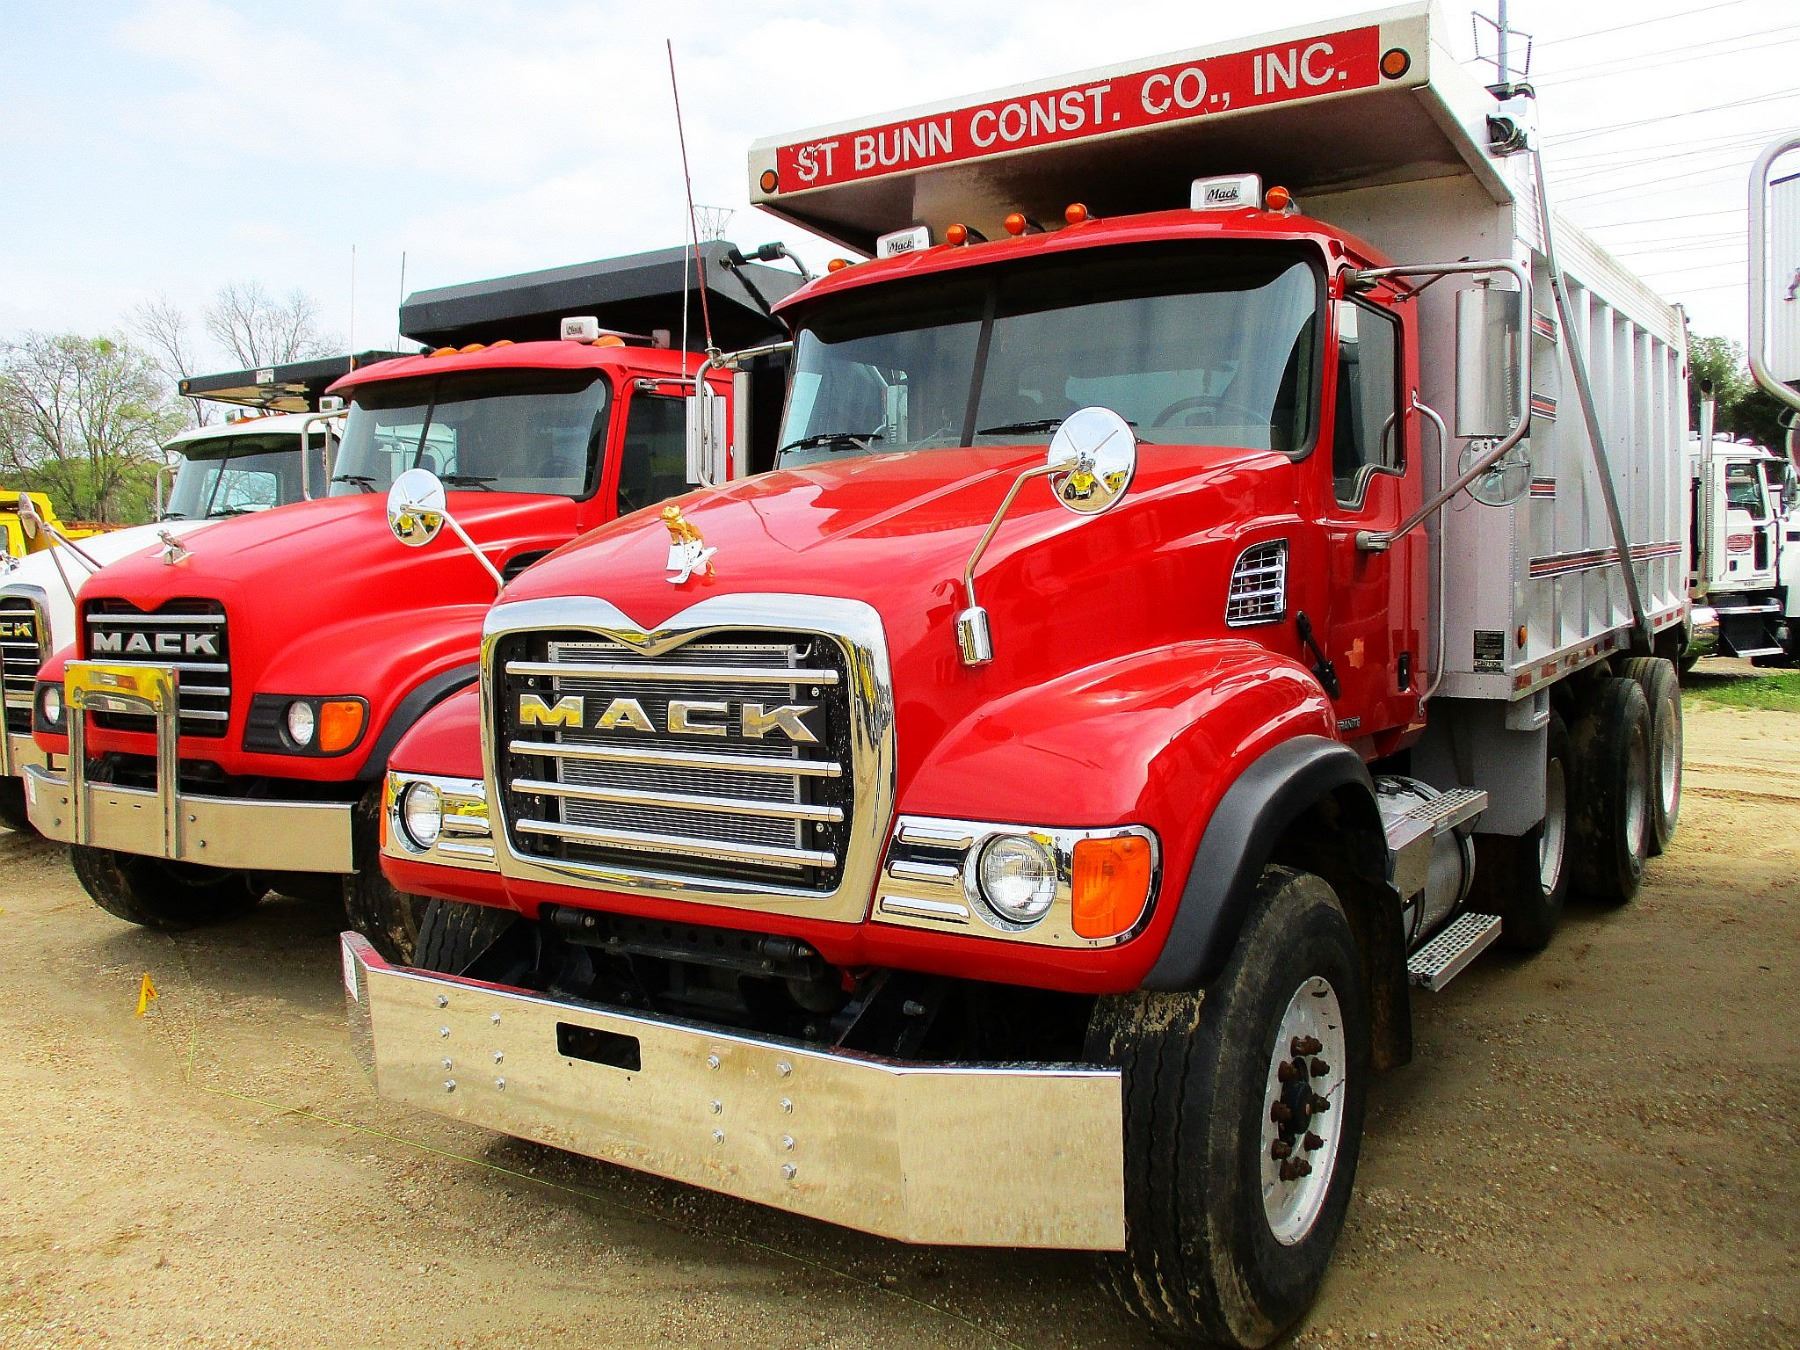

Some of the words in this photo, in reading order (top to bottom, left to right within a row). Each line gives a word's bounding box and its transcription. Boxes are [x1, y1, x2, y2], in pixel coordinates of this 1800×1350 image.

[798, 141, 839, 182] ST
[854, 118, 953, 171] BUNN
[970, 85, 1120, 148] CONST.
[1141, 67, 1230, 115] CO.,
[1254, 42, 1347, 96] INC.
[1207, 187, 1239, 201] Mack
[889, 238, 913, 253] Mack
[0, 622, 32, 637] CK
[93, 632, 219, 655] MACK
[519, 694, 820, 743] MACK
